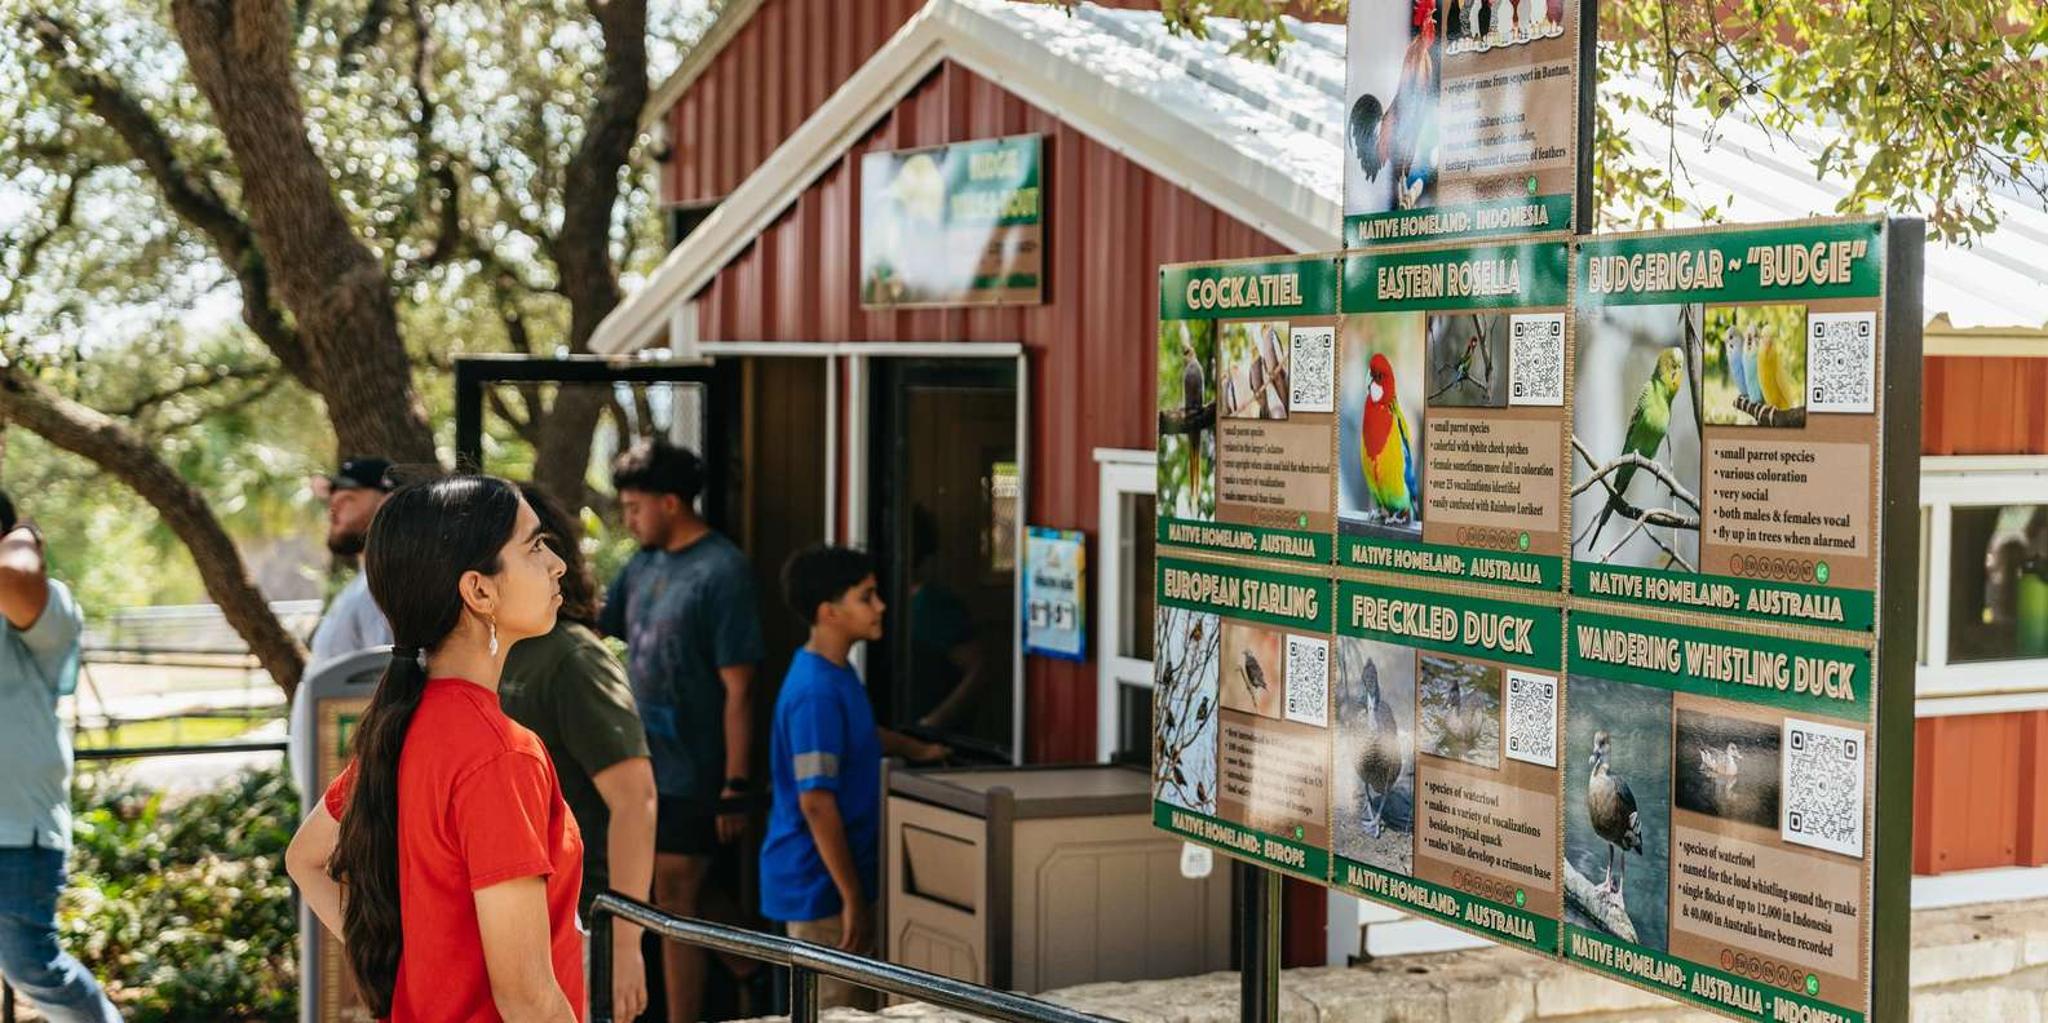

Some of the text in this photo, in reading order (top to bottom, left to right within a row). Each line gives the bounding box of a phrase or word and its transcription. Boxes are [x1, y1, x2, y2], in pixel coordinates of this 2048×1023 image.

[1493, 74, 1508, 86] from
[1534, 68, 1542, 80] in
[1542, 66, 1570, 79] Bantam,
[1530, 147, 1538, 160] of
[1538, 145, 1566, 159] feathers
[1359, 205, 1549, 239] NATIVE HOMELAND: INDONESIA
[1378, 259, 1520, 300] EASTERN ROSELLA
[1589, 249, 1723, 294] BUDGERIGAR
[1187, 273, 1302, 310] COCKATIEL
[1434, 420, 1490, 436] small parrot species
[1433, 438, 1528, 457] colorful with white cheek patches
[1719, 445, 1815, 465] small parrot species
[1453, 459, 1483, 472] sometimes
[1484, 464, 1499, 473] more
[1500, 461, 1513, 474] dull
[1514, 462, 1520, 474] in
[1520, 463, 1554, 476] coloration
[1719, 465, 1808, 483] various coloration
[1432, 480, 1445, 489] over
[1453, 479, 1491, 492] vocalizations
[1492, 481, 1520, 494] identified
[1718, 486, 1768, 502] very social
[1432, 496, 1543, 515] easily confused with Rainbow Lorikeet
[1718, 504, 1850, 527] both males & females vocal
[1169, 524, 1315, 557] NATIVE HOMELAND: AUSTRALIA
[1718, 524, 1855, 548] fly up in trees when alarmed
[1352, 545, 1542, 583] NATIVE HOMELAND: AUSTRALIA
[1165, 569, 1318, 620] EUROPEAN STARLING
[1590, 571, 1844, 621] NATIVE HOMELAND: AUSTRALIA
[1352, 595, 1534, 654] FRECKLED DUCK
[1577, 625, 1854, 700] WANDERING WHISTLING DUCK
[1428, 782, 1499, 807] species of waterfowl
[1428, 799, 1540, 837] makes a variety of vocalizations
[1428, 816, 1502, 846] besides typical quack
[1172, 811, 1203, 836] NATIVE
[1206, 821, 1261, 854] HOMELAND:
[1265, 839, 1305, 868] EUROPE
[1682, 842, 1755, 868] species of waterfowl
[1450, 840, 1465, 856] bills
[1466, 845, 1494, 867] develop
[1495, 857, 1500, 866] a
[1501, 857, 1532, 874] crimson
[1533, 863, 1551, 880] base
[1348, 865, 1388, 894] NATIVE
[1390, 879, 1460, 917] HOMELAND:
[1465, 903, 1536, 942] AUSTRALIA
[1682, 864, 1856, 916] named for the loud whistling sound they make
[1682, 882, 1832, 933] single flocks of up to 12,000 in Indonesia
[1682, 903, 1833, 956] & 40,000 in Australia have been recorded
[1572, 934, 1613, 967] NATIVE
[1615, 949, 1686, 990] HOMELAND:
[1691, 972, 1762, 1016] AUSTRALIA
[1774, 996, 1851, 1023] INDONE
